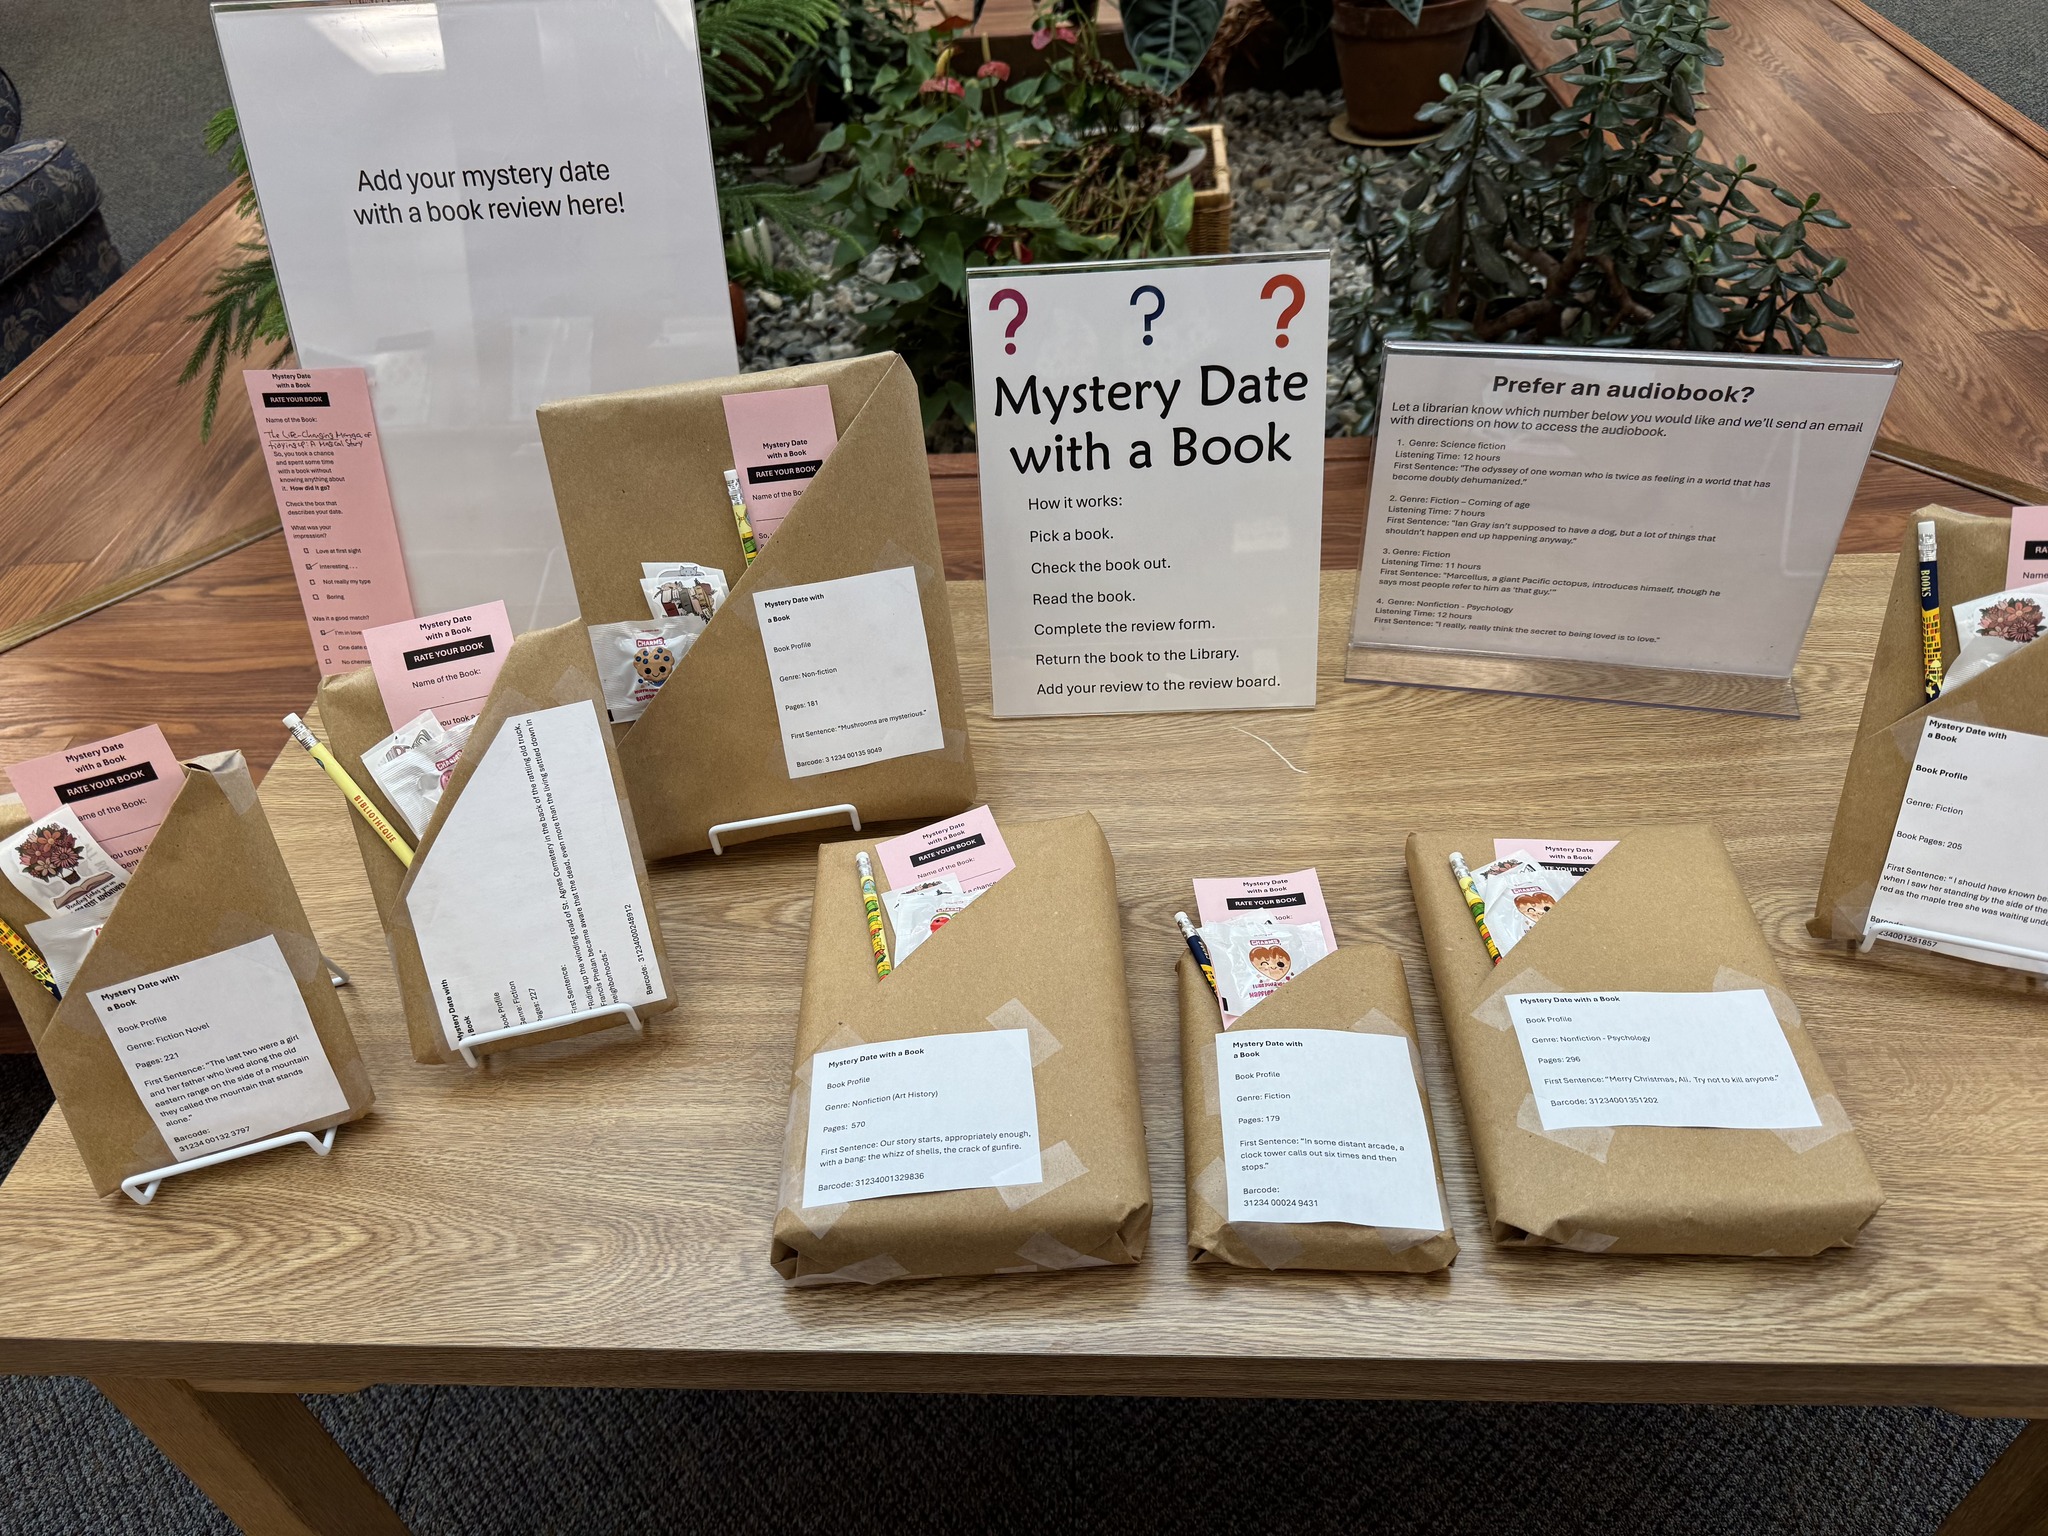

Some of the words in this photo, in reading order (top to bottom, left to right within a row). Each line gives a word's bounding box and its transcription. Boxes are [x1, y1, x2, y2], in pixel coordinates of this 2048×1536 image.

[358, 168, 402, 192] Add
[406, 171, 455, 195] your
[462, 165, 552, 191] mystery
[559, 160, 609, 182] date
[353, 202, 403, 225] with
[408, 206, 422, 223] a
[426, 199, 484, 222] book
[488, 196, 561, 219] review
[567, 191, 624, 215] here!
[994, 374, 1181, 425] Mystery
[1200, 364, 1308, 406] Date
[1492, 375, 1566, 394] Prefer
[1570, 382, 1600, 396] an
[1606, 382, 1755, 403] audiobook?
[1390, 415, 1414, 425] with
[1417, 415, 1474, 427] directions
[1476, 420, 1491, 428] on
[1493, 419, 1519, 429] how
[1521, 421, 1533, 430] to
[1535, 423, 1577, 432] access
[1580, 423, 1599, 433] the
[1601, 425, 1666, 437] audiobook.
[1392, 402, 1410, 411] Let
[1422, 402, 1468, 413] librarian
[1471, 404, 1503, 415] know
[1505, 406, 1540, 416] which
[1542, 409, 1590, 419] number
[1591, 410, 1629, 421] below
[1629, 414, 1652, 424] you
[1655, 414, 1692, 424] would
[1694, 414, 1715, 425] like
[1717, 417, 1742, 427] and
[1744, 418, 1773, 428] we’ll
[1775, 419, 1807, 429] send
[1808, 422, 1825, 430] an
[1827, 422, 1863, 432] email
[264, 430, 279, 438] The
[1009, 431, 1110, 474] with
[1129, 440, 1152, 469] a
[1172, 421, 1292, 466] Book
[1408, 439, 1438, 447] Genre:
[1440, 440, 1476, 449] Science
[1477, 441, 1505, 450] fiction
[1395, 450, 1435, 460] Listening
[1436, 451, 1460, 460] Time:
[1028, 497, 1060, 510] How
[1064, 496, 1073, 508] it
[1075, 494, 1122, 508] works:
[1030, 529, 1059, 542] Pick
[1062, 531, 1070, 541] a
[1075, 527, 1113, 540] book.
[1031, 561, 1076, 574] Check
[1078, 560, 1101, 572] the
[1105, 558, 1140, 571] book
[1143, 557, 1170, 569] out.
[1921, 570, 1931, 597] BOOKS
[1033, 592, 1067, 605] Read
[1071, 592, 1093, 603] the
[1097, 590, 1135, 602] book.
[1034, 622, 1101, 637] Complete
[1105, 621, 1127, 633] the
[1131, 619, 1175, 632] review
[1178, 618, 1215, 630] form.
[413, 652, 434, 662] RATE
[434, 647, 459, 657] YOUR
[459, 641, 484, 652] BOOK
[1036, 654, 1080, 665] Return
[1083, 652, 1106, 663] the
[1109, 650, 1143, 663] book
[1146, 651, 1160, 661] to
[1163, 649, 1186, 660] the
[1190, 648, 1239, 661] Library.
[411, 678, 435, 688] Name
[436, 675, 444, 683] of
[445, 673, 458, 681] the
[458, 668, 481, 678] Book:
[779, 674, 800, 682] Genre:
[801, 667, 837, 678] Non-fiction
[1036, 683, 1063, 695] Add
[1066, 684, 1096, 696] your
[1100, 680, 1143, 693] review
[1146, 681, 1160, 691] to
[1163, 679, 1185, 690] the
[1189, 677, 1233, 689] review
[1236, 675, 1280, 688] board.
[785, 703, 805, 711] Pages:
[1928, 719, 1964, 733] Mystery
[1965, 726, 1986, 736] Date
[1988, 731, 2007, 739] with
[66, 784, 90, 796] RATE
[89, 778, 117, 790] YOUR
[116, 769, 145, 783] BOOK
[1906, 798, 1934, 809] Genre:
[1935, 803, 1963, 815] Fiction
[1897, 831, 1917, 841] Book
[1918, 835, 1945, 847] Pages:
[1946, 841, 1962, 850] 205
[100, 987, 136, 1000] Mystery
[137, 981, 159, 991] Date
[159, 974, 179, 984] with
[641, 964, 653, 995] Barcode:
[113, 999, 137, 1010] Book
[126, 1039, 155, 1051] Genre:
[155, 1031, 184, 1043] Fiction
[184, 1022, 210, 1034] Novel
[135, 1057, 163, 1069] Pages:
[163, 1052, 179, 1061] 221
[828, 1058, 858, 1068] Mystery
[859, 1054, 877, 1062] Date
[824, 1102, 850, 1111] Genre:
[851, 1095, 891, 1107] Nonfiction
[892, 1093, 906, 1101] (Art
[907, 1090, 938, 1098] History)
[1550, 1098, 1587, 1106] Barcode:
[1588, 1096, 1658, 1104] 31234001351202
[822, 1124, 847, 1133] Pages:
[851, 1120, 865, 1128] 570
[818, 1181, 853, 1191] Barcode:
[855, 1172, 924, 1186] 31234001329836
